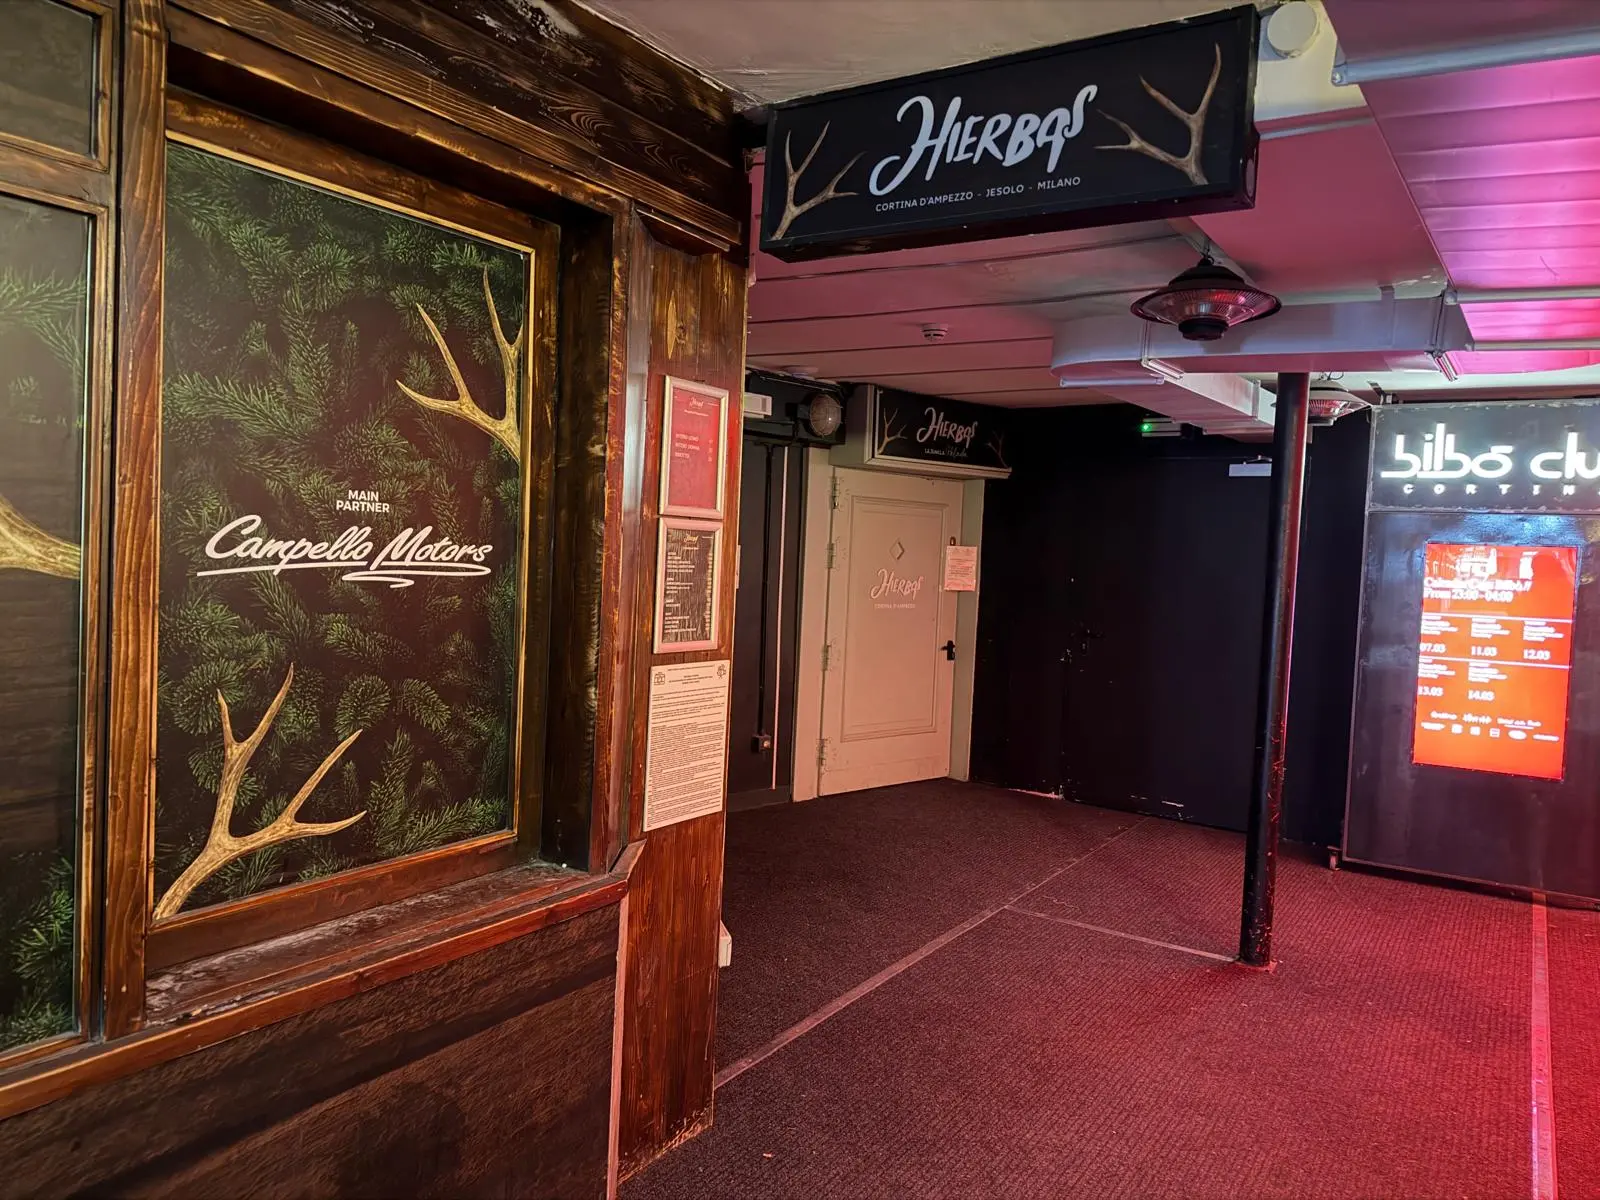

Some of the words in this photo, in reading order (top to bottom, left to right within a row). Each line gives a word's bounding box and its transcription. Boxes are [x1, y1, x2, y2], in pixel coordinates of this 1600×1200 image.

[875, 198, 918, 213] CORTINA
[919, 190, 974, 206] D'AMPEZZO
[985, 184, 1024, 198] JESOLO
[1037, 176, 1081, 190] MILANO
[347, 489, 379, 502] MAIN
[1403, 483, 1600, 495] CORTIN
[336, 500, 390, 514] PARTNER
[205, 514, 373, 575] Campello
[370, 525, 494, 571] Motors
[1470, 645, 1498, 657] 11.03
[1523, 648, 1551, 661] 12.03
